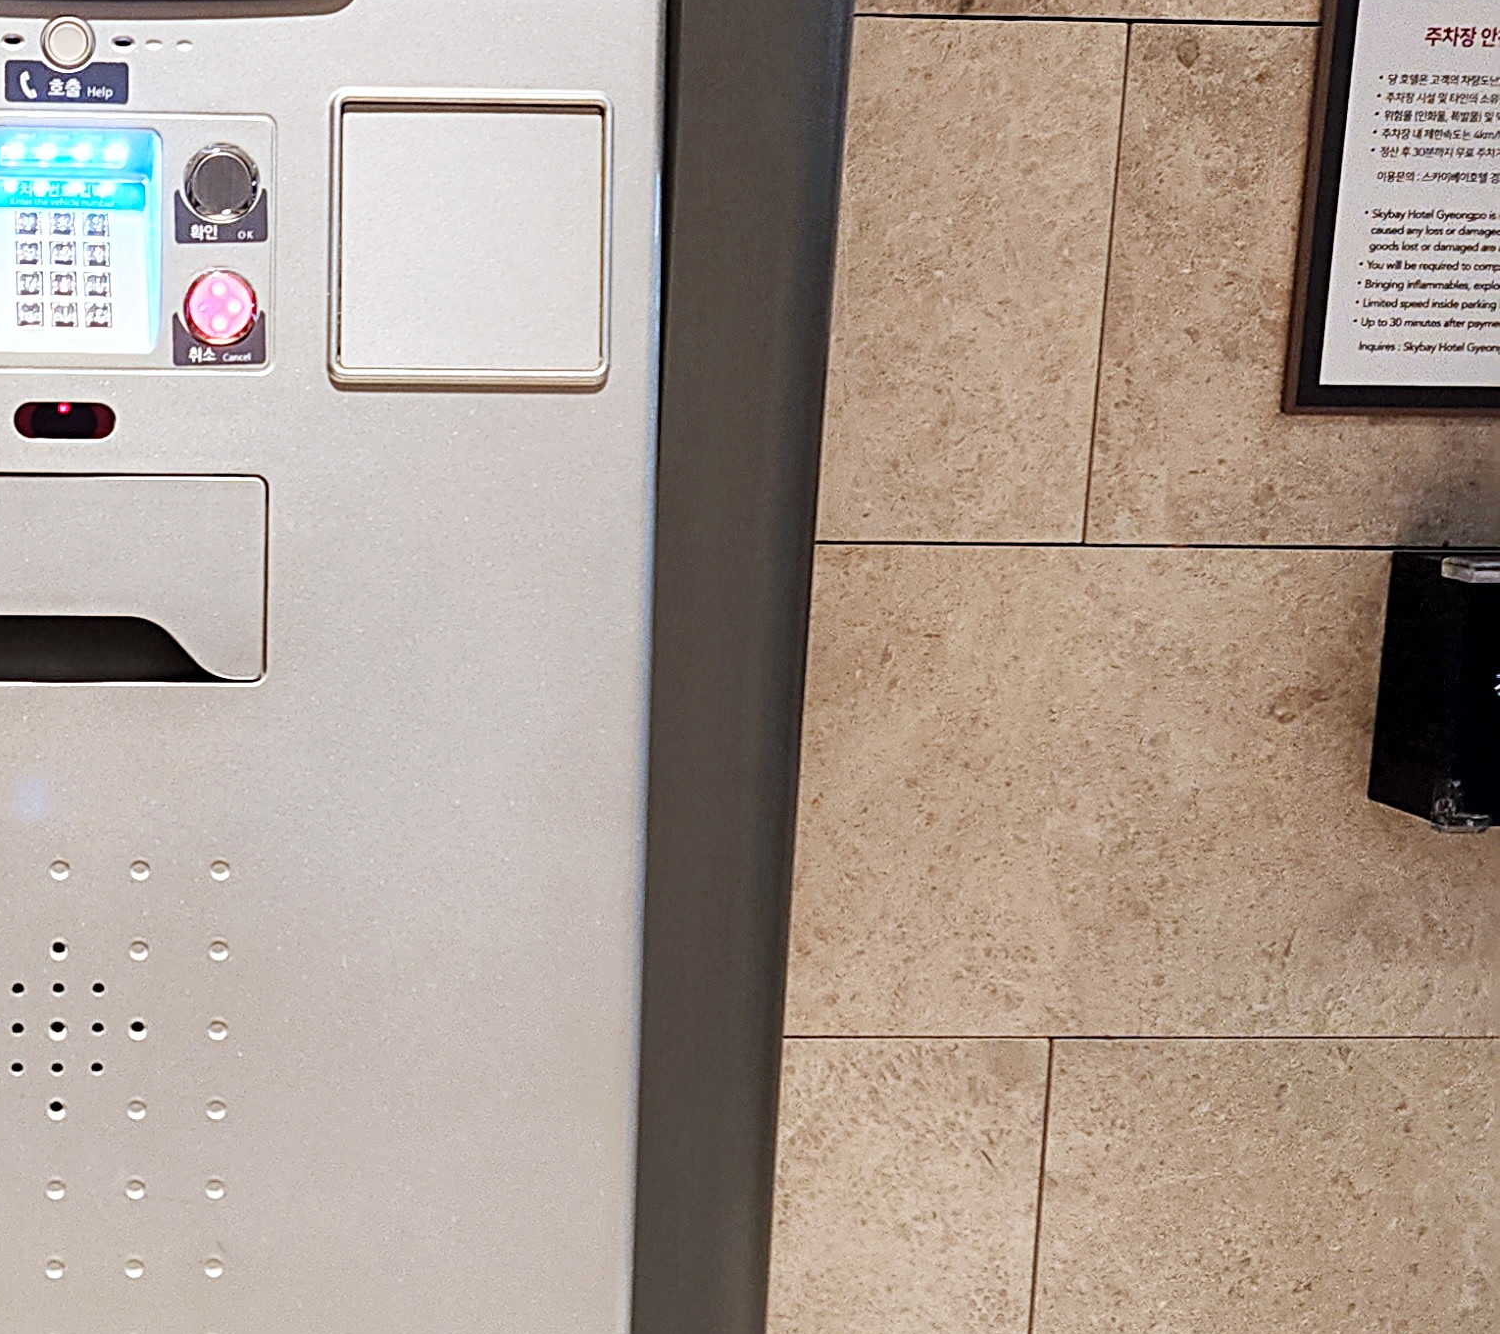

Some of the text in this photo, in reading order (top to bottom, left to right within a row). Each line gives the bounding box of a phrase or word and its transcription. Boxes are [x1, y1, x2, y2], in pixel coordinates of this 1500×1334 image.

[1425, 26, 1500, 48] 주차장 안
[48, 78, 81, 98] 호출
[87, 86, 113, 100] Help
[33, 198, 48, 206] the
[1372, 208, 1406, 221] Skybay
[1408, 209, 1435, 219] Hotel
[1436, 210, 1487, 222] Gyeongpo
[190, 224, 218, 241] 확인
[237, 231, 254, 239] OK
[1371, 225, 1404, 235] caused
[1406, 228, 1424, 237] any
[1425, 225, 1443, 235] loss
[1369, 241, 1399, 253] goods
[1402, 241, 1419, 251] lost
[1434, 241, 1480, 254] damaged
[1367, 260, 1385, 270] You
[1386, 260, 1402, 269] will
[1404, 260, 1416, 270] be
[1419, 261, 1459, 272] required
[1462, 262, 1471, 271] to
[1365, 279, 1404, 291] Bringing
[1363, 298, 1497, 312] Limited speed inside parking
[1361, 317, 1375, 328] Up
[1377, 319, 1388, 327] to
[1389, 318, 1402, 327] 30
[1404, 319, 1441, 327] minutes
[1443, 318, 1465, 327] after
[1403, 341, 1437, 354] Skybay
[1438, 342, 1465, 352] Hotel
[188, 346, 217, 363] 취소
[222, 353, 251, 362] Cancel
